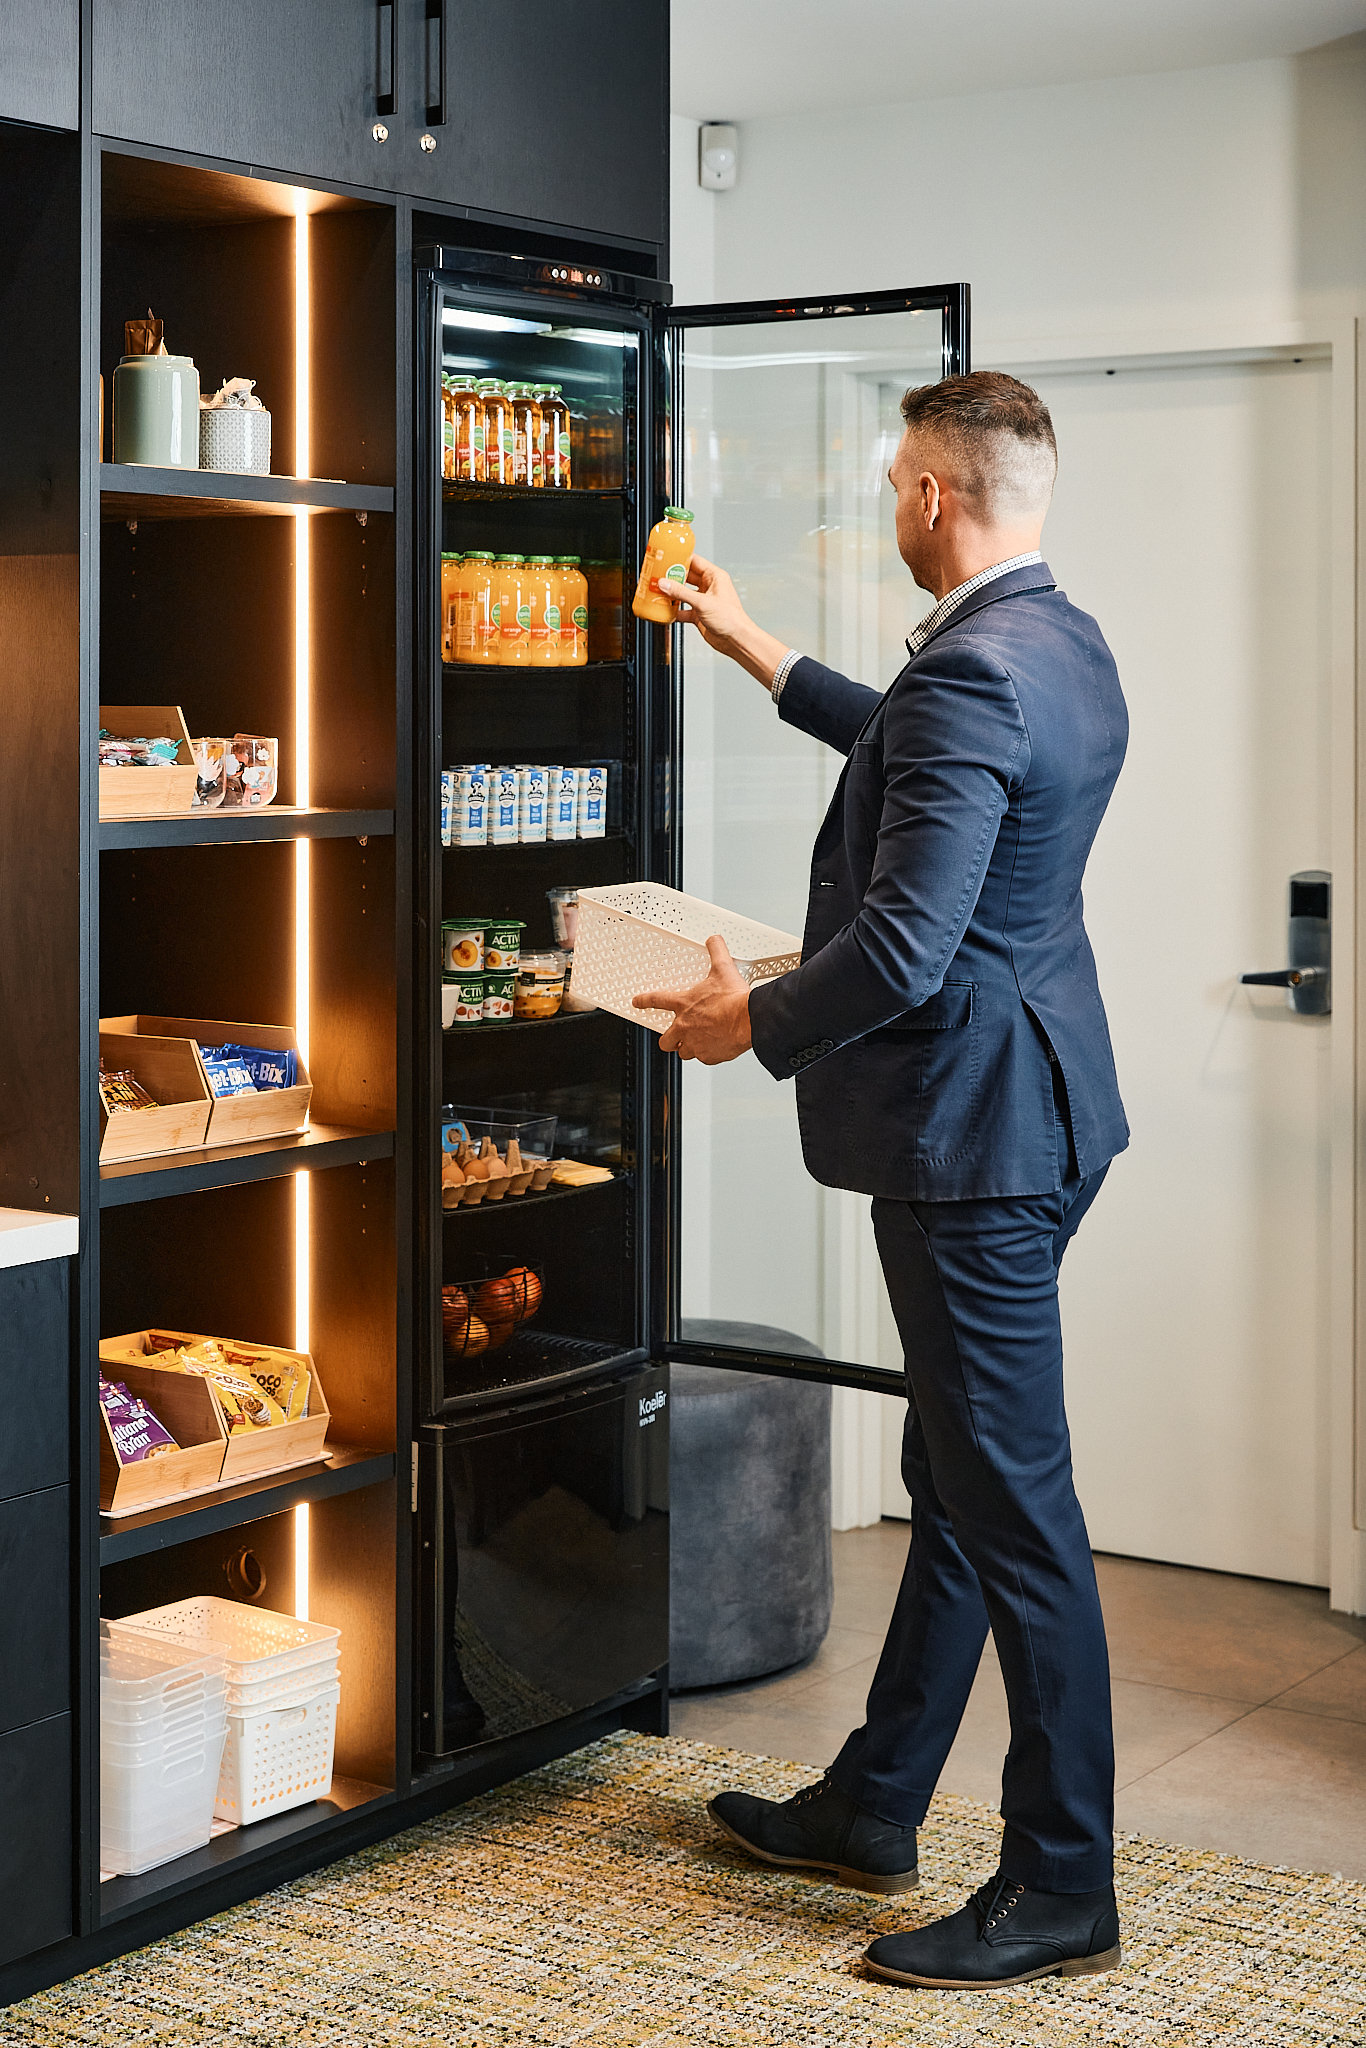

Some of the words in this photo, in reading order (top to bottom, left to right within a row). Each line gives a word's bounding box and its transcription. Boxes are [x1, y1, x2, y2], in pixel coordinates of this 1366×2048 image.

[208, 1067, 254, 1091] et-Bix
[246, 1063, 286, 1084] t-Bix
[113, 1418, 150, 1443] ultana
[118, 1432, 152, 1455] Bran
